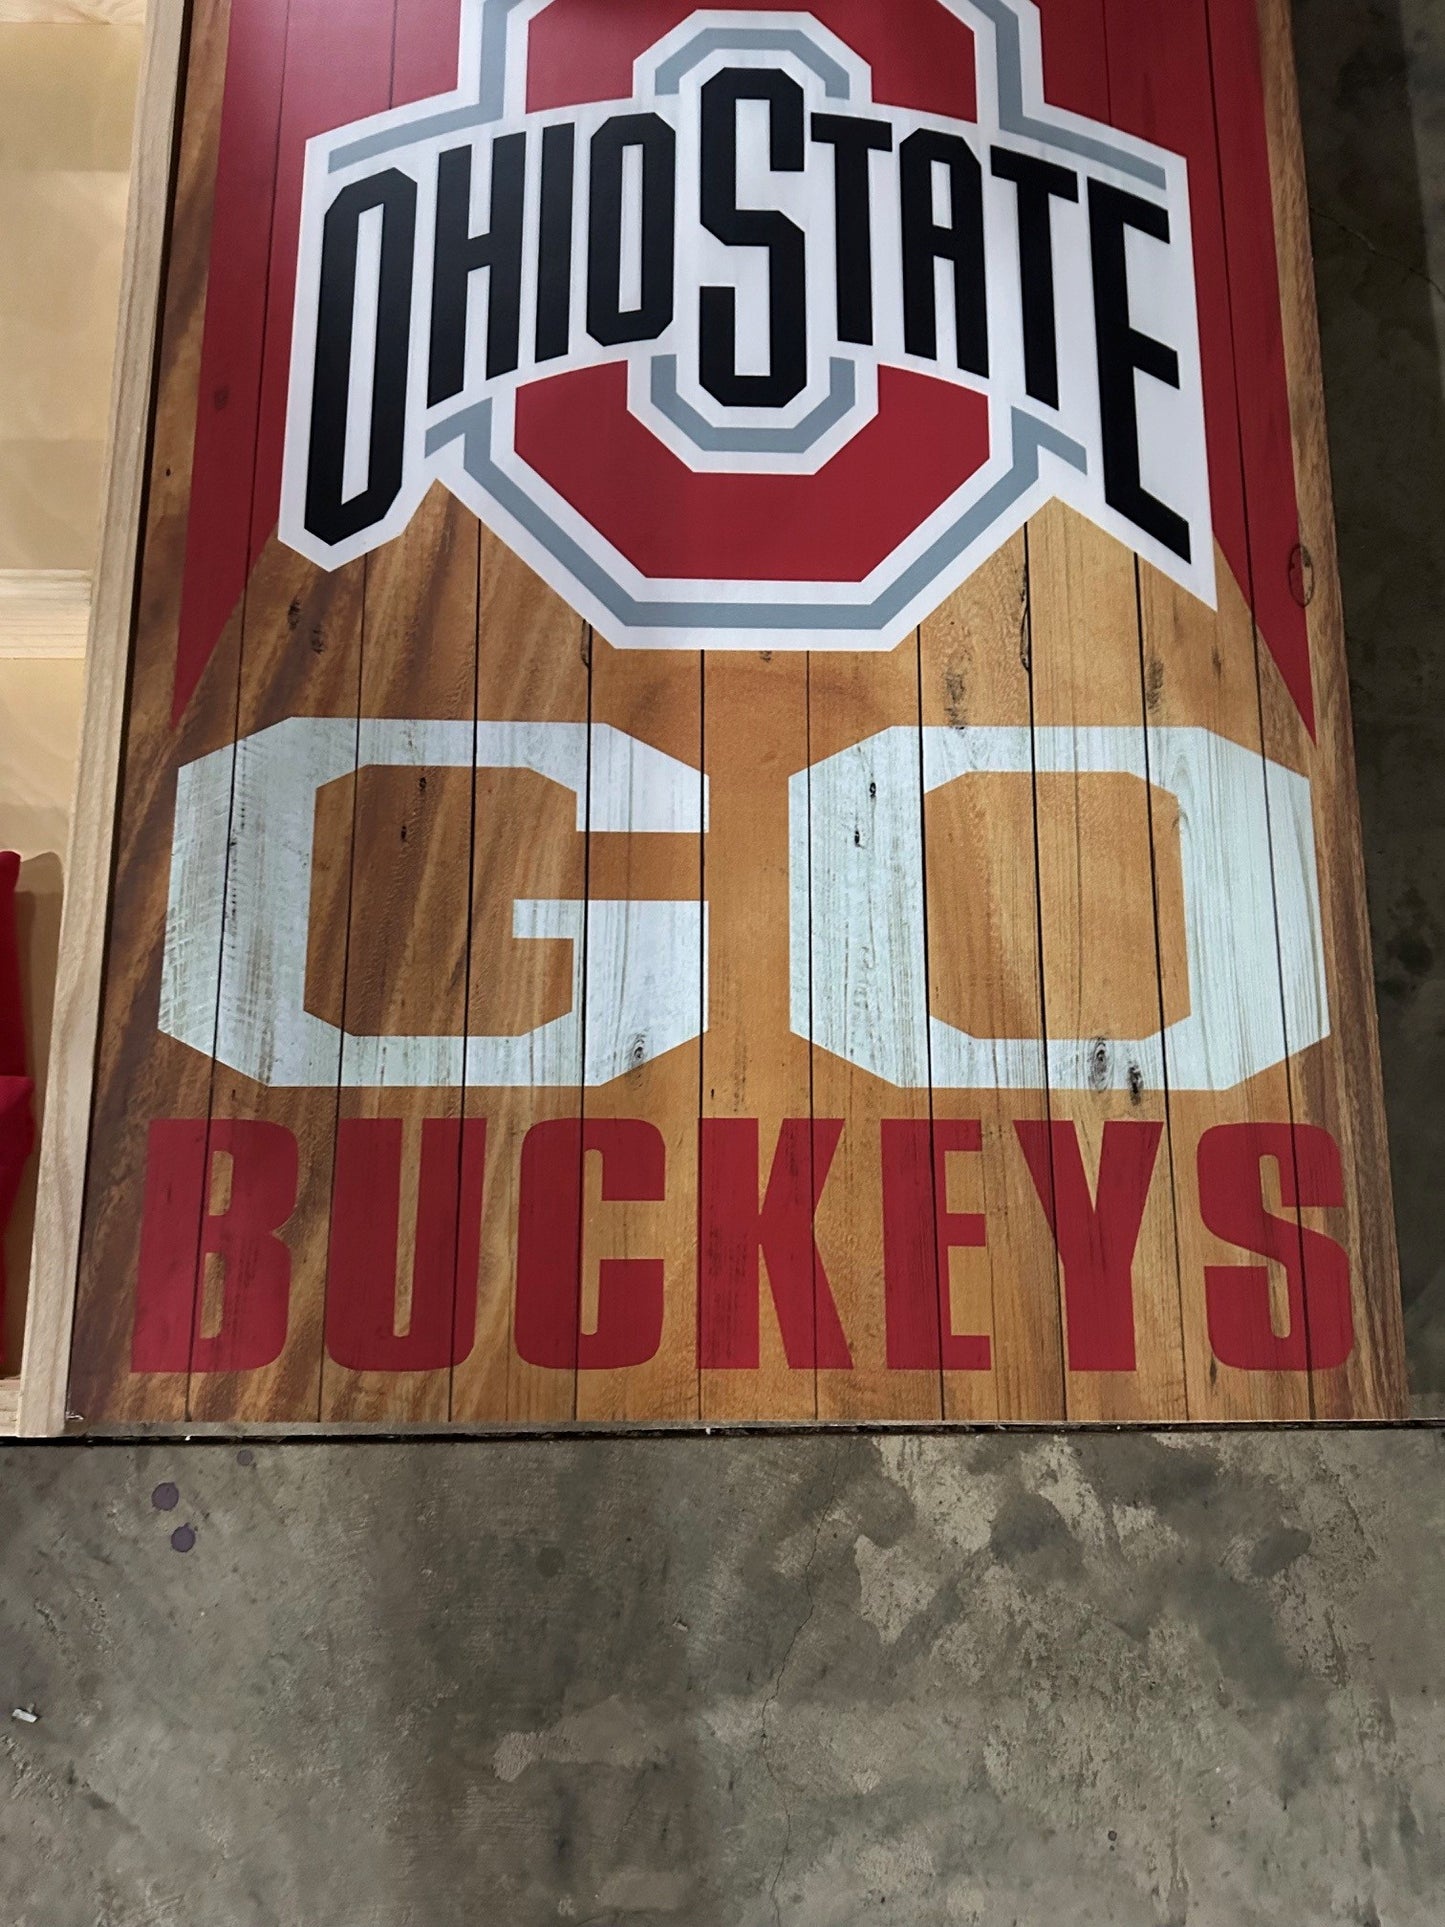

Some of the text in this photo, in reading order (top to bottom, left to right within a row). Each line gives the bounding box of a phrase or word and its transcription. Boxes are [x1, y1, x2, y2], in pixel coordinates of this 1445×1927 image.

[303, 67, 1192, 565] OHIO STATE
[158, 716, 1331, 1091] GO
[130, 1118, 1357, 1373] BUCKEYS
